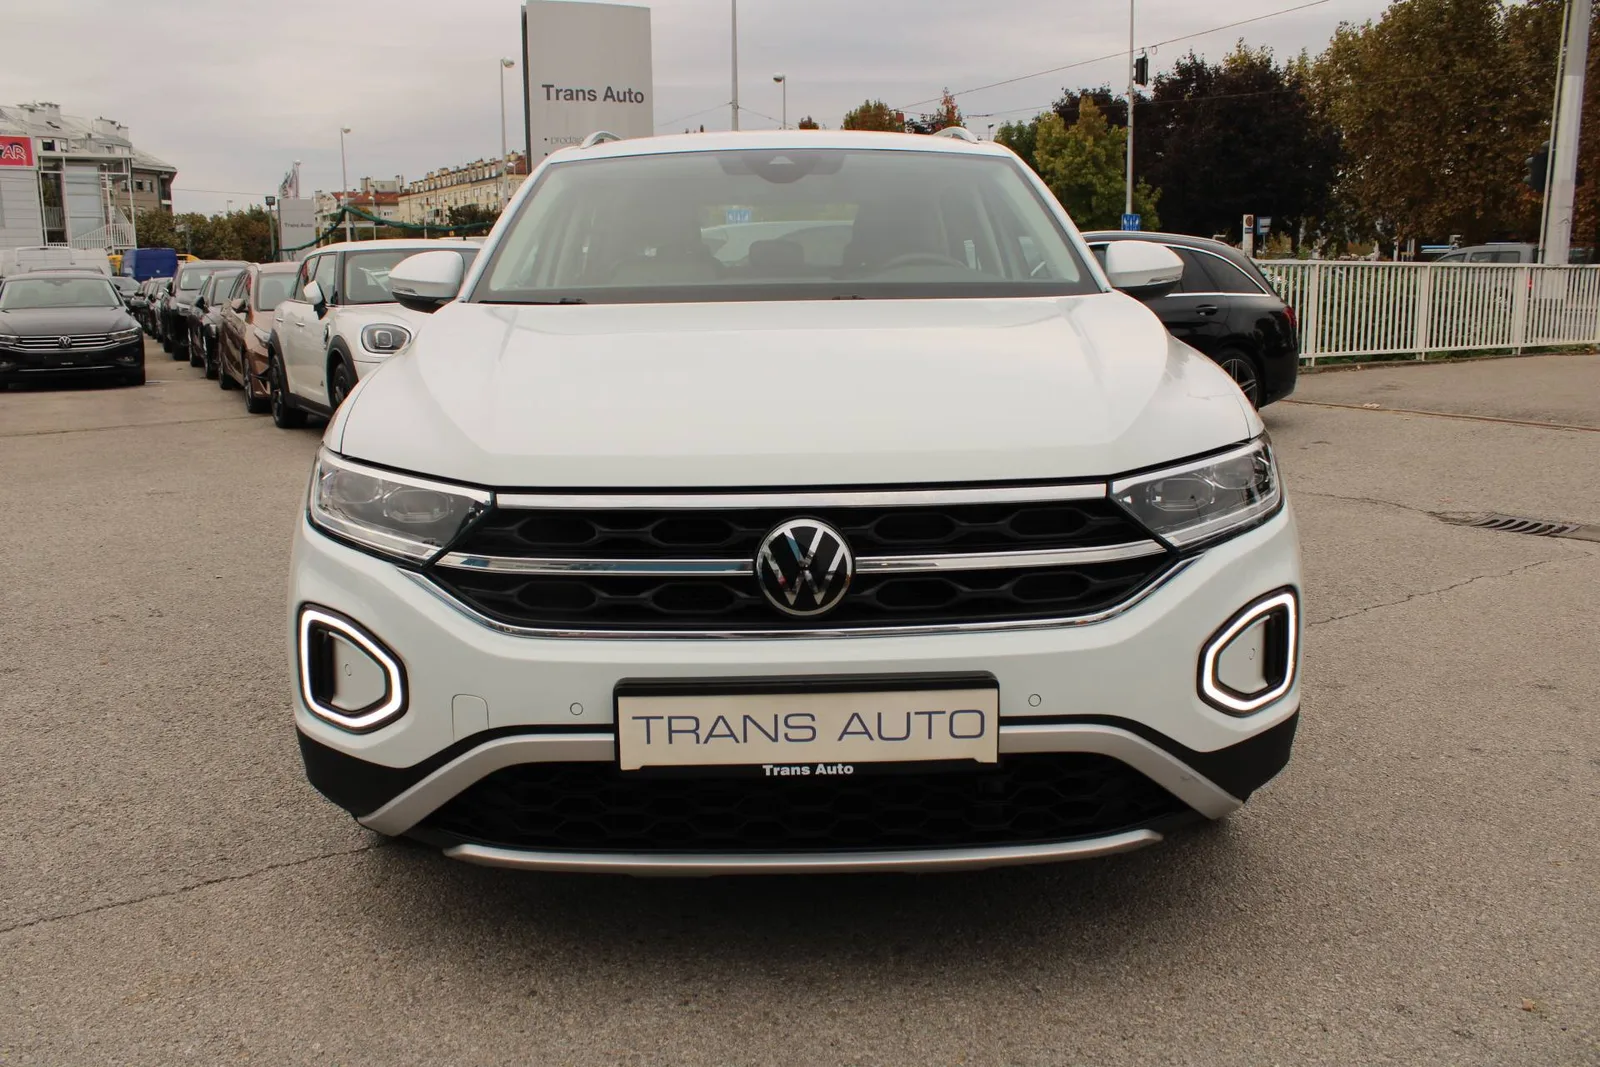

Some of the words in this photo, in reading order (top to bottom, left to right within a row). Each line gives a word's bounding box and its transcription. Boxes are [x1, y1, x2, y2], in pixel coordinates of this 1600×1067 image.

[542, 84, 598, 102] Trans
[602, 86, 645, 104] Auto
[631, 712, 817, 745] TRANS
[837, 709, 985, 742] AUTO
[762, 764, 811, 776] Trans
[815, 763, 854, 775] Auto
